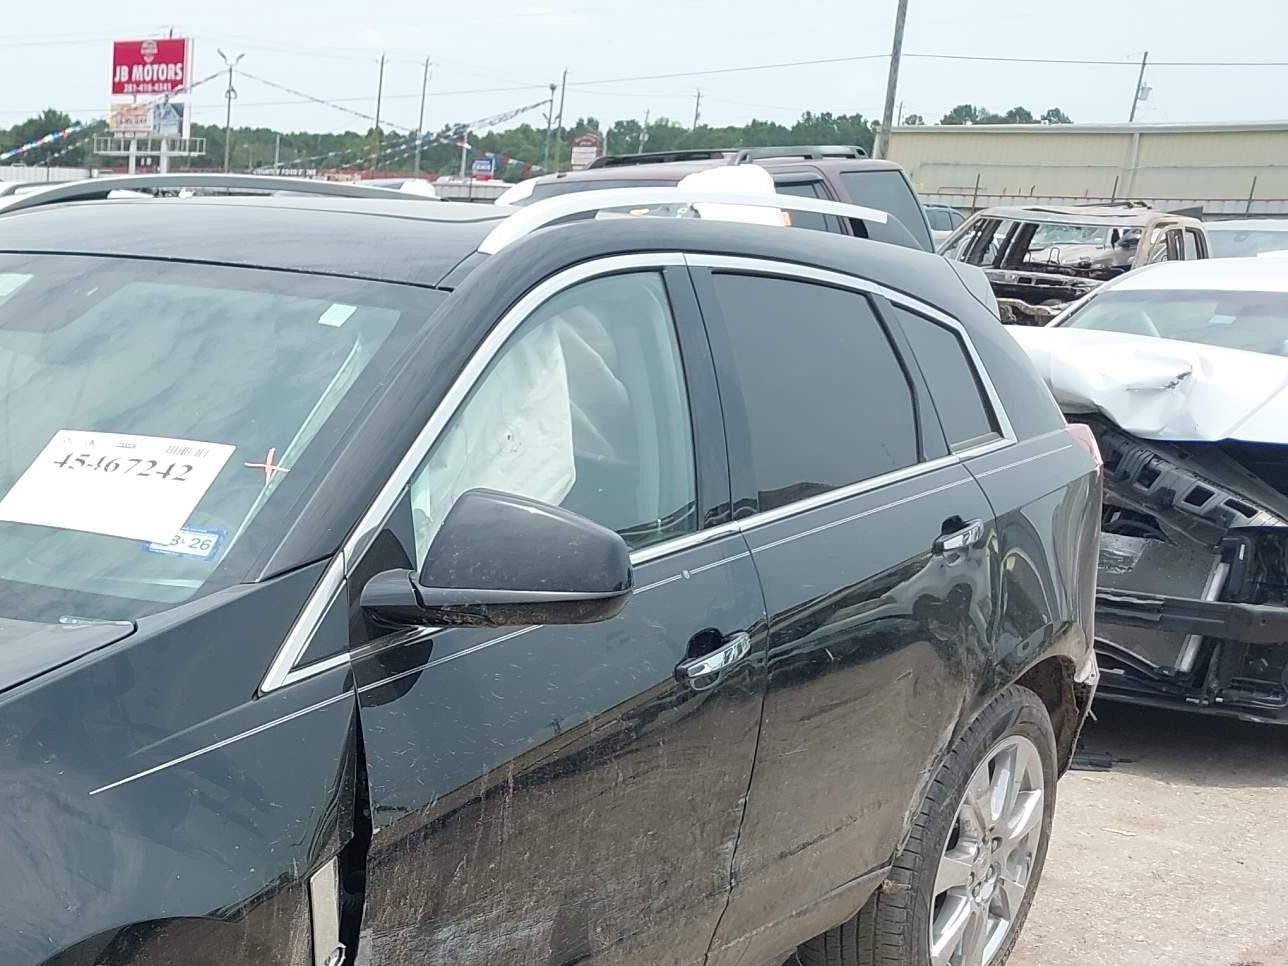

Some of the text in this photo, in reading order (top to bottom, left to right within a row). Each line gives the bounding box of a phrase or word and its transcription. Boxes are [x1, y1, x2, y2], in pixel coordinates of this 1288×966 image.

[114, 63, 183, 82] JB MOTORS
[53, 452, 194, 482] 45467242
